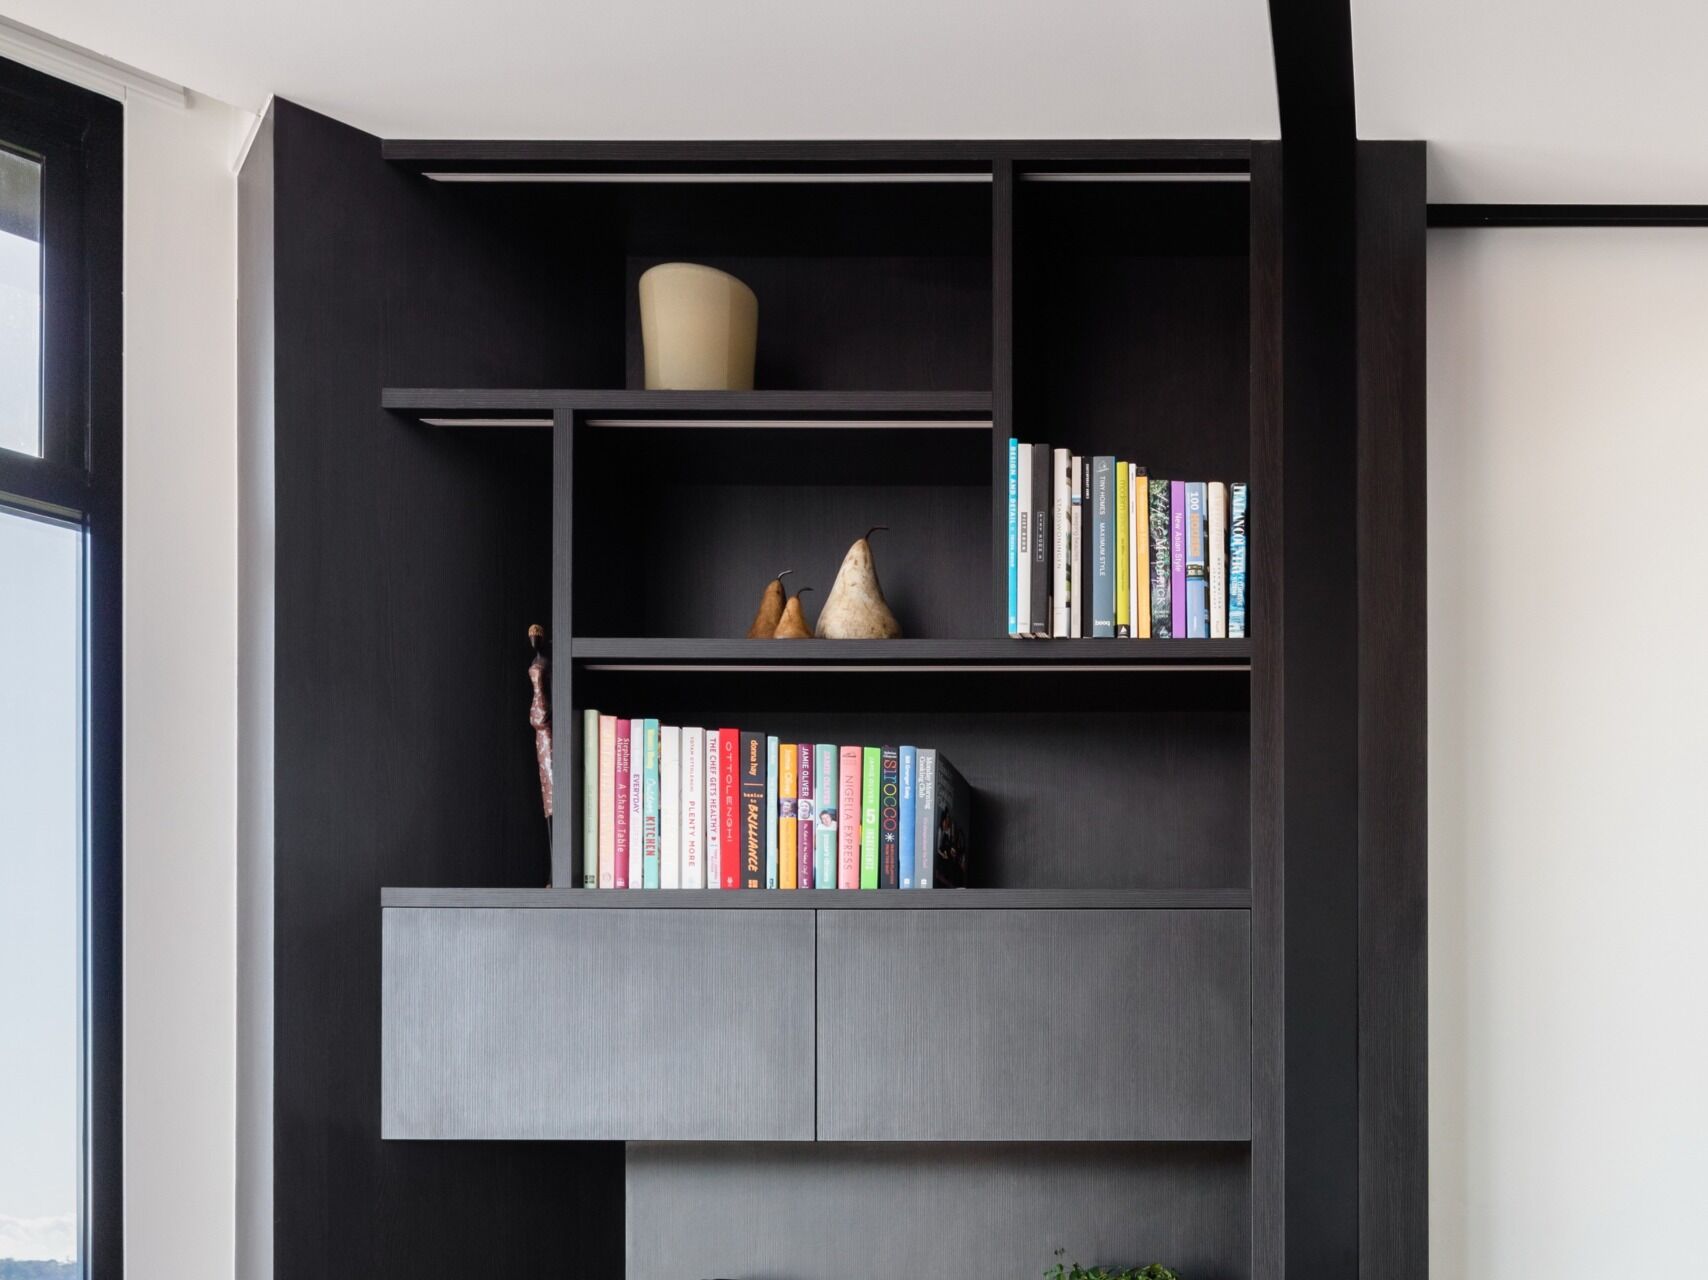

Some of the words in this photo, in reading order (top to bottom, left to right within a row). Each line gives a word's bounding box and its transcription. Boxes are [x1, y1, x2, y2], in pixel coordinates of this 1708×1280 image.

[1191, 492, 1199, 510] 100
[1174, 553, 1182, 571] Style
[622, 737, 630, 773] Stephanie
[750, 740, 758, 762] donna
[801, 746, 809, 768] JAMIE
[748, 763, 758, 776] hay
[918, 756, 926, 782] Cooking
[925, 756, 933, 782] Monday
[801, 770, 809, 797] OLIVER
[924, 783, 932, 810] Morning
[617, 794, 626, 824] Shared
[844, 775, 854, 820] NIGELLA
[617, 829, 626, 852] Table
[646, 816, 656, 856] KITCHEN
[748, 804, 758, 872] BRILLIANCE
[844, 825, 853, 870] EXPRESS
